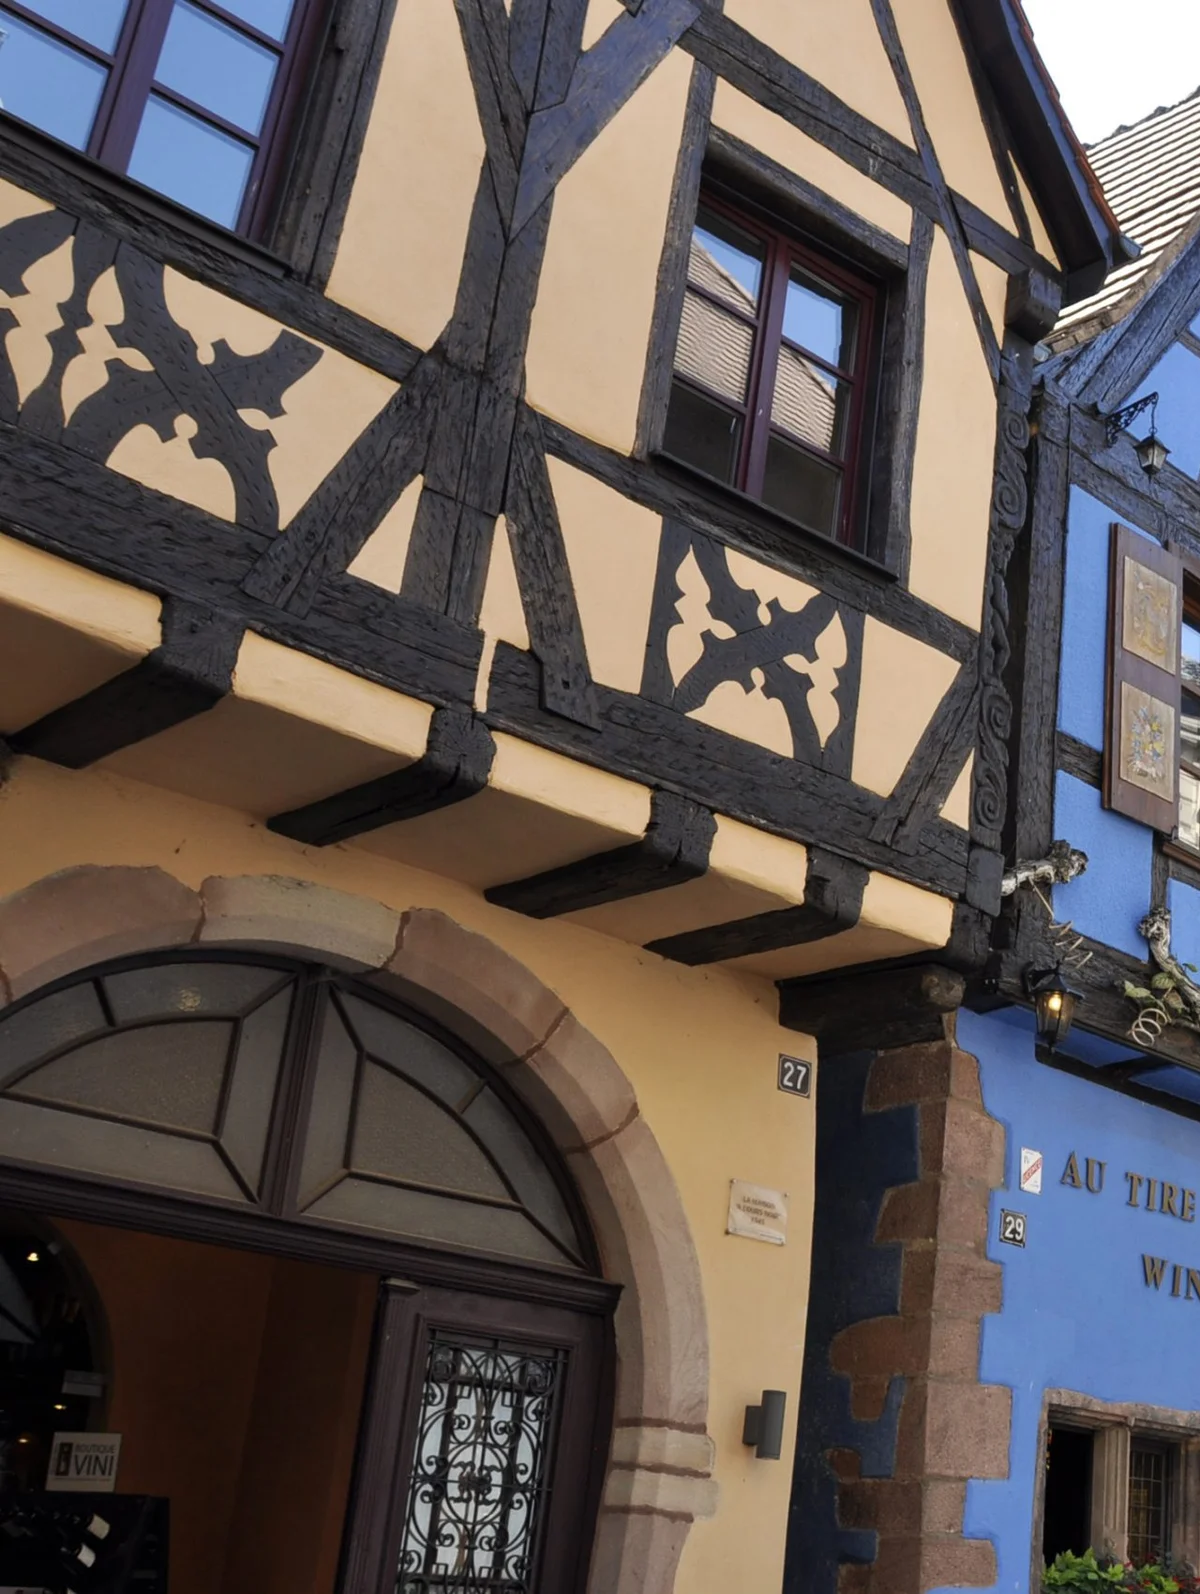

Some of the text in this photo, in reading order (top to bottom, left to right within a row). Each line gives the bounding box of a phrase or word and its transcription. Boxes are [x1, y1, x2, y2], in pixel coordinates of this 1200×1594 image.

[783, 1061, 807, 1090] 27
[1060, 1151, 1108, 1195] AU
[1124, 1171, 1197, 1222] TIRE
[1004, 1215, 1024, 1241] 29
[74, 1454, 114, 1476] VINI
